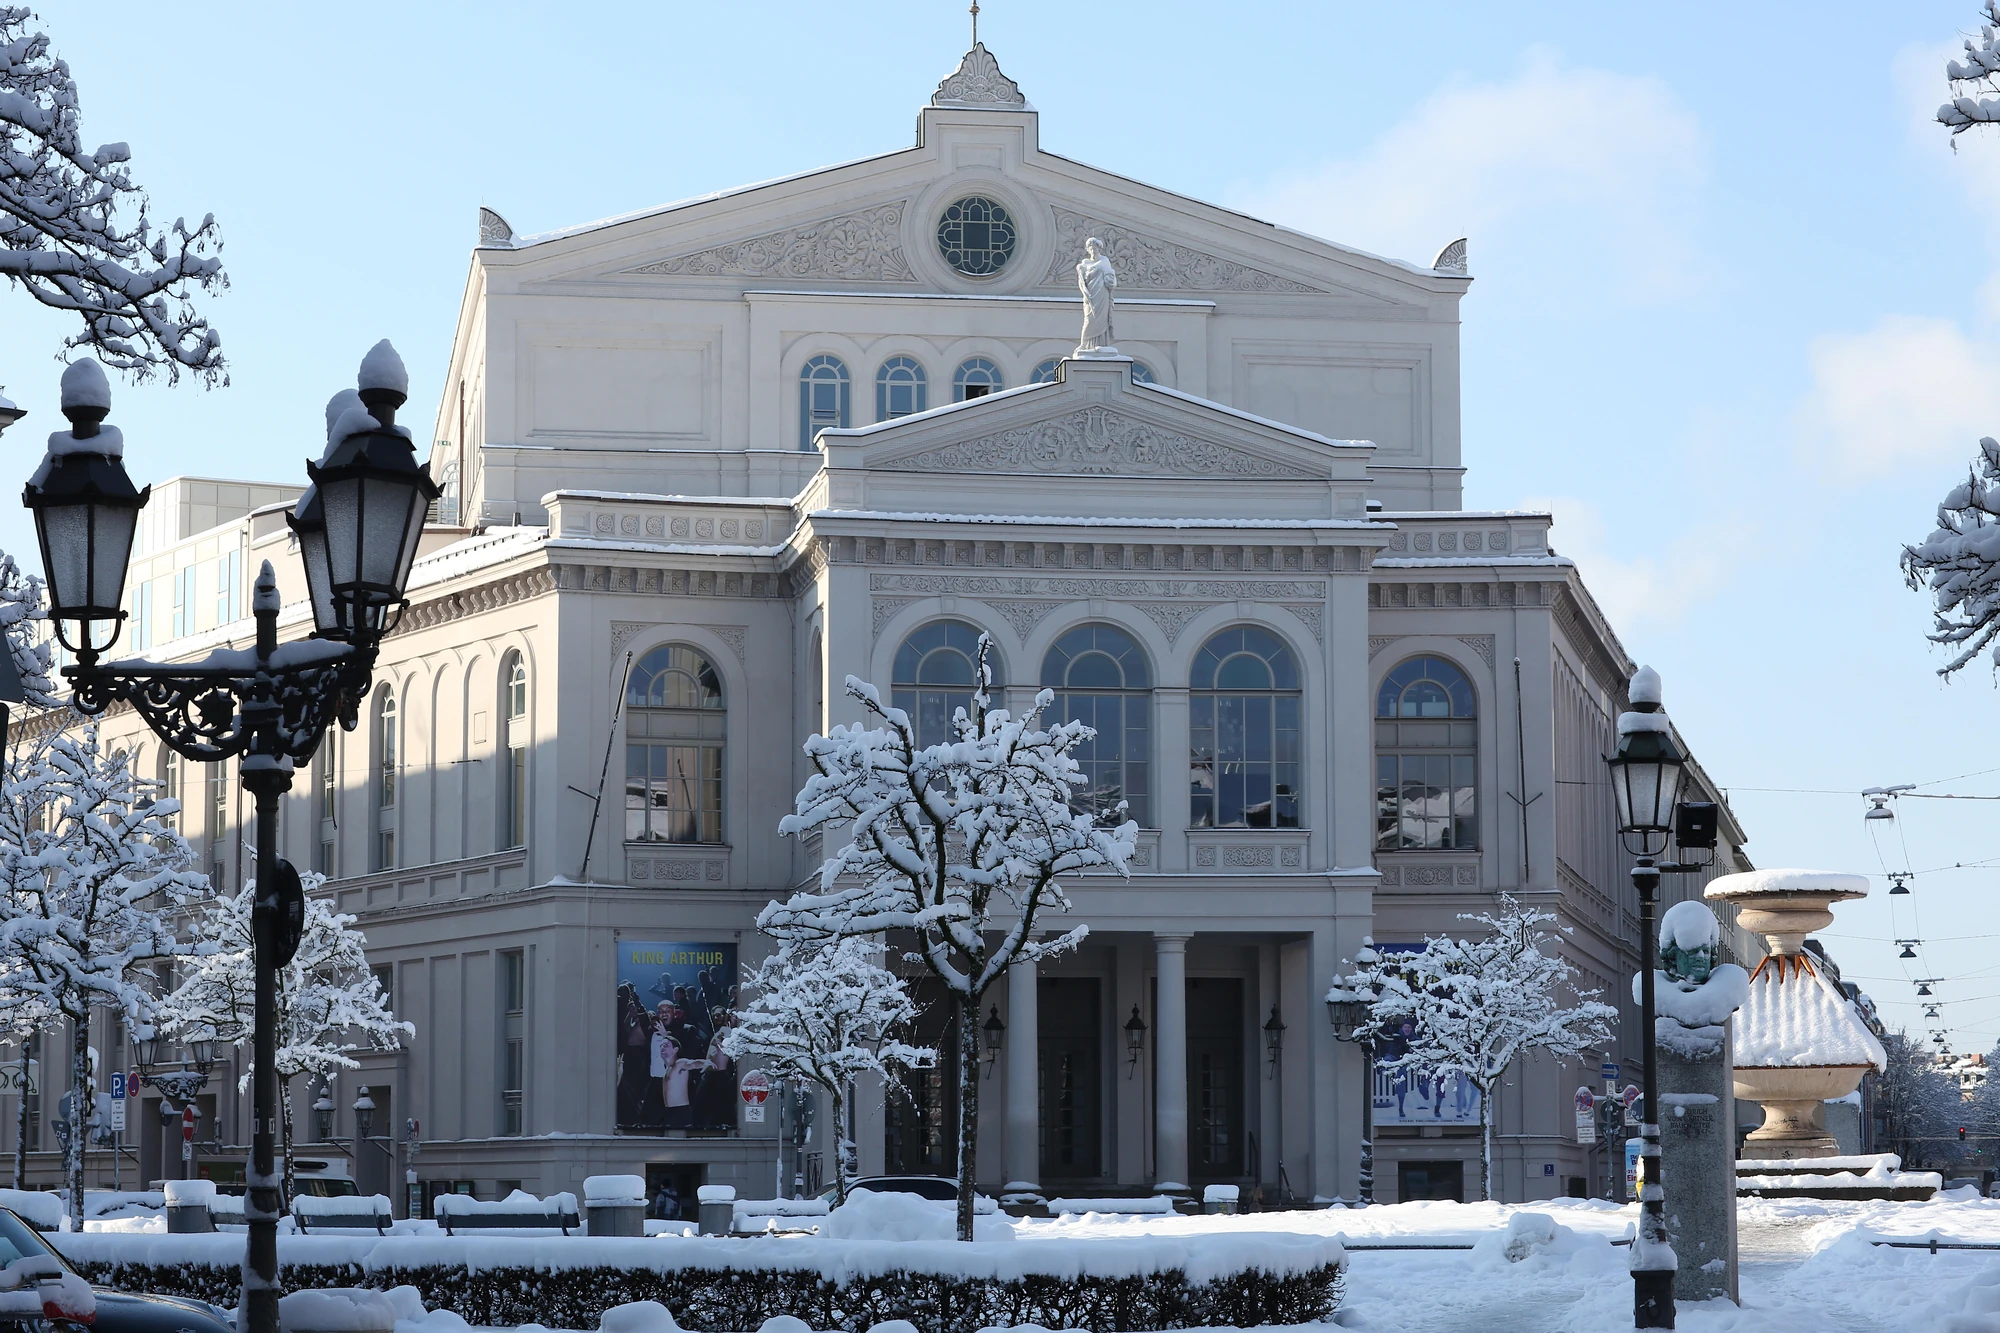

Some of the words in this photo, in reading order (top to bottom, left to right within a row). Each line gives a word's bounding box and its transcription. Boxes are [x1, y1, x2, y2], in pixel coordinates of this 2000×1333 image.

[632, 951, 665, 965] KING
[670, 951, 723, 965] ARTHUR
[113, 1077, 121, 1096] P
